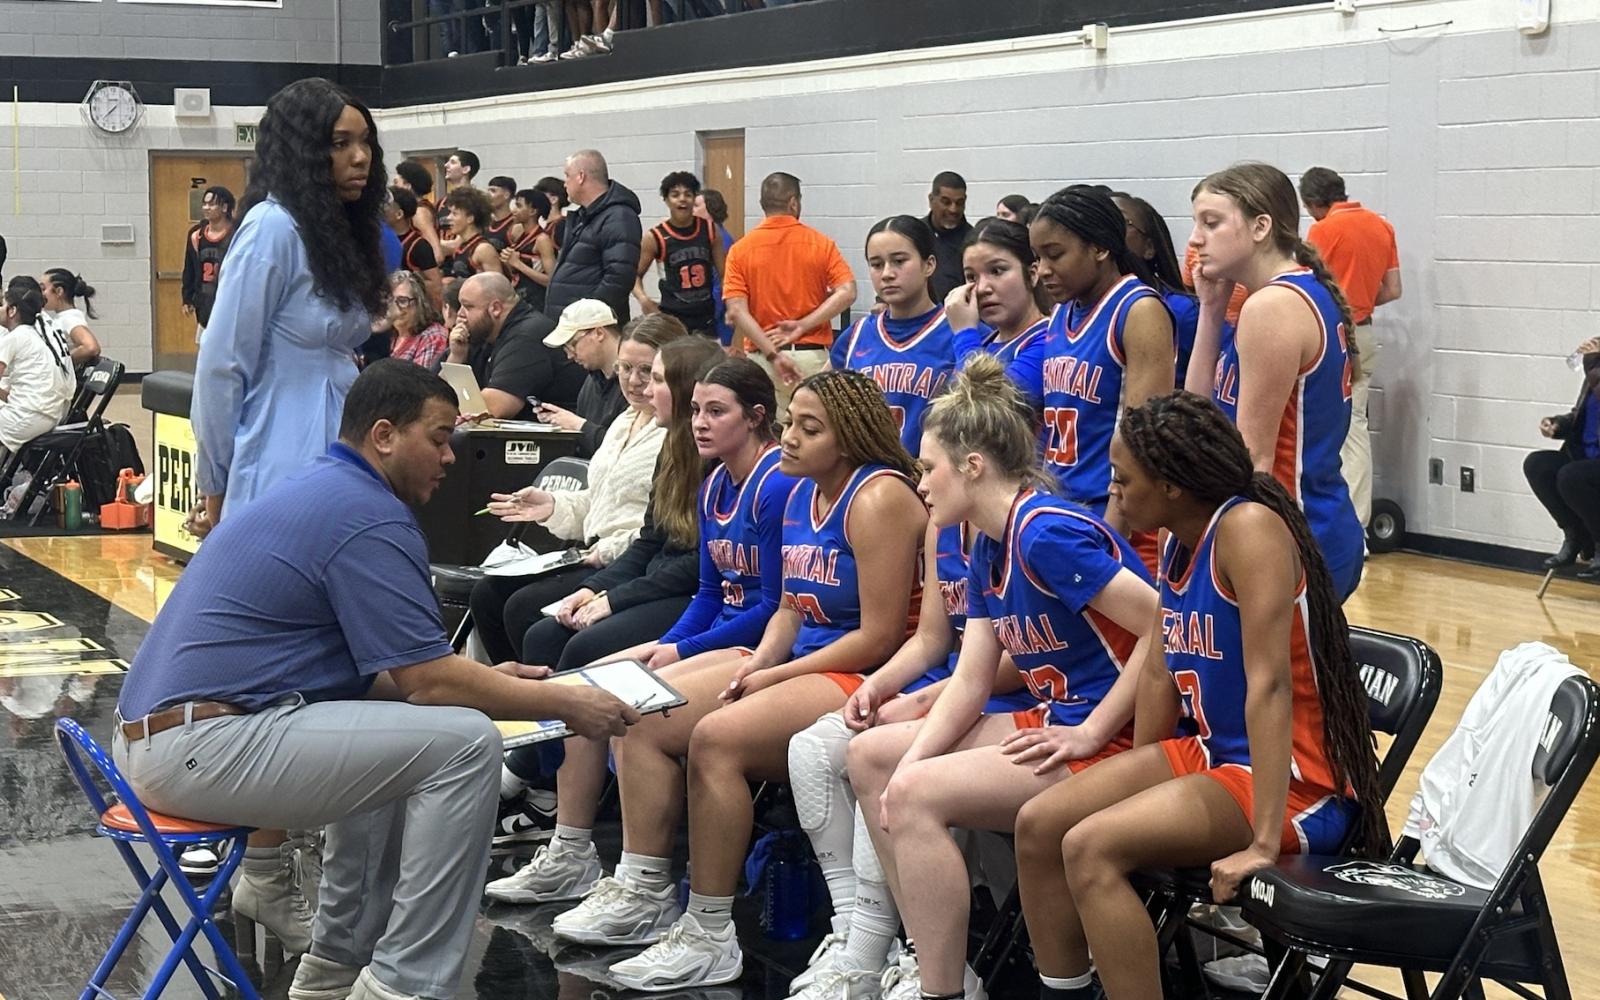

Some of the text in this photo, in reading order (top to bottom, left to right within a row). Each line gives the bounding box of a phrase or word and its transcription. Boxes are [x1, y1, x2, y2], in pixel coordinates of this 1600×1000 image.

[680, 264, 705, 289] 13
[1044, 407, 1078, 466] 20
[158, 444, 198, 514] PER
[1251, 875, 1274, 907] MOJO
